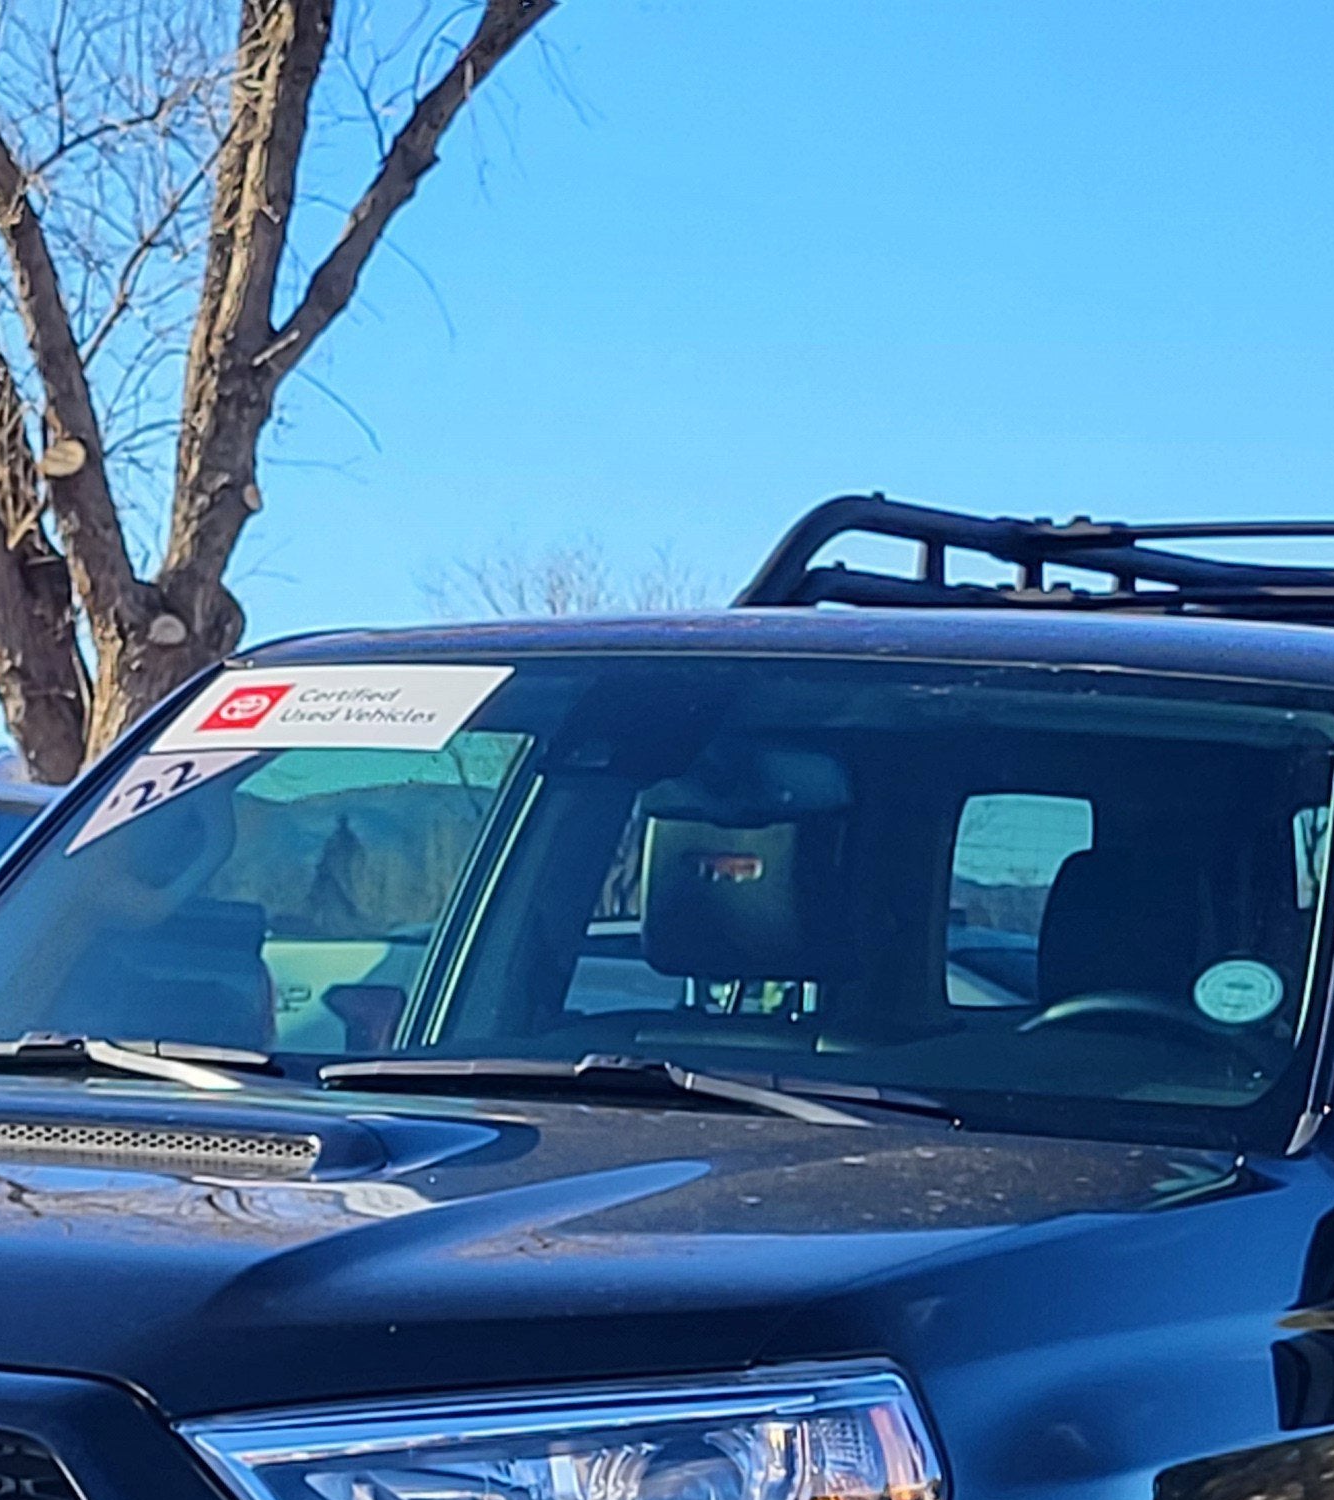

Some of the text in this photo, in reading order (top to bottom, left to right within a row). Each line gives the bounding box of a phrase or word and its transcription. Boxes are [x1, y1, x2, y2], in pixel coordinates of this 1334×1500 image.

[297, 686, 402, 703] Certified
[278, 707, 439, 725] Used Vehicles
